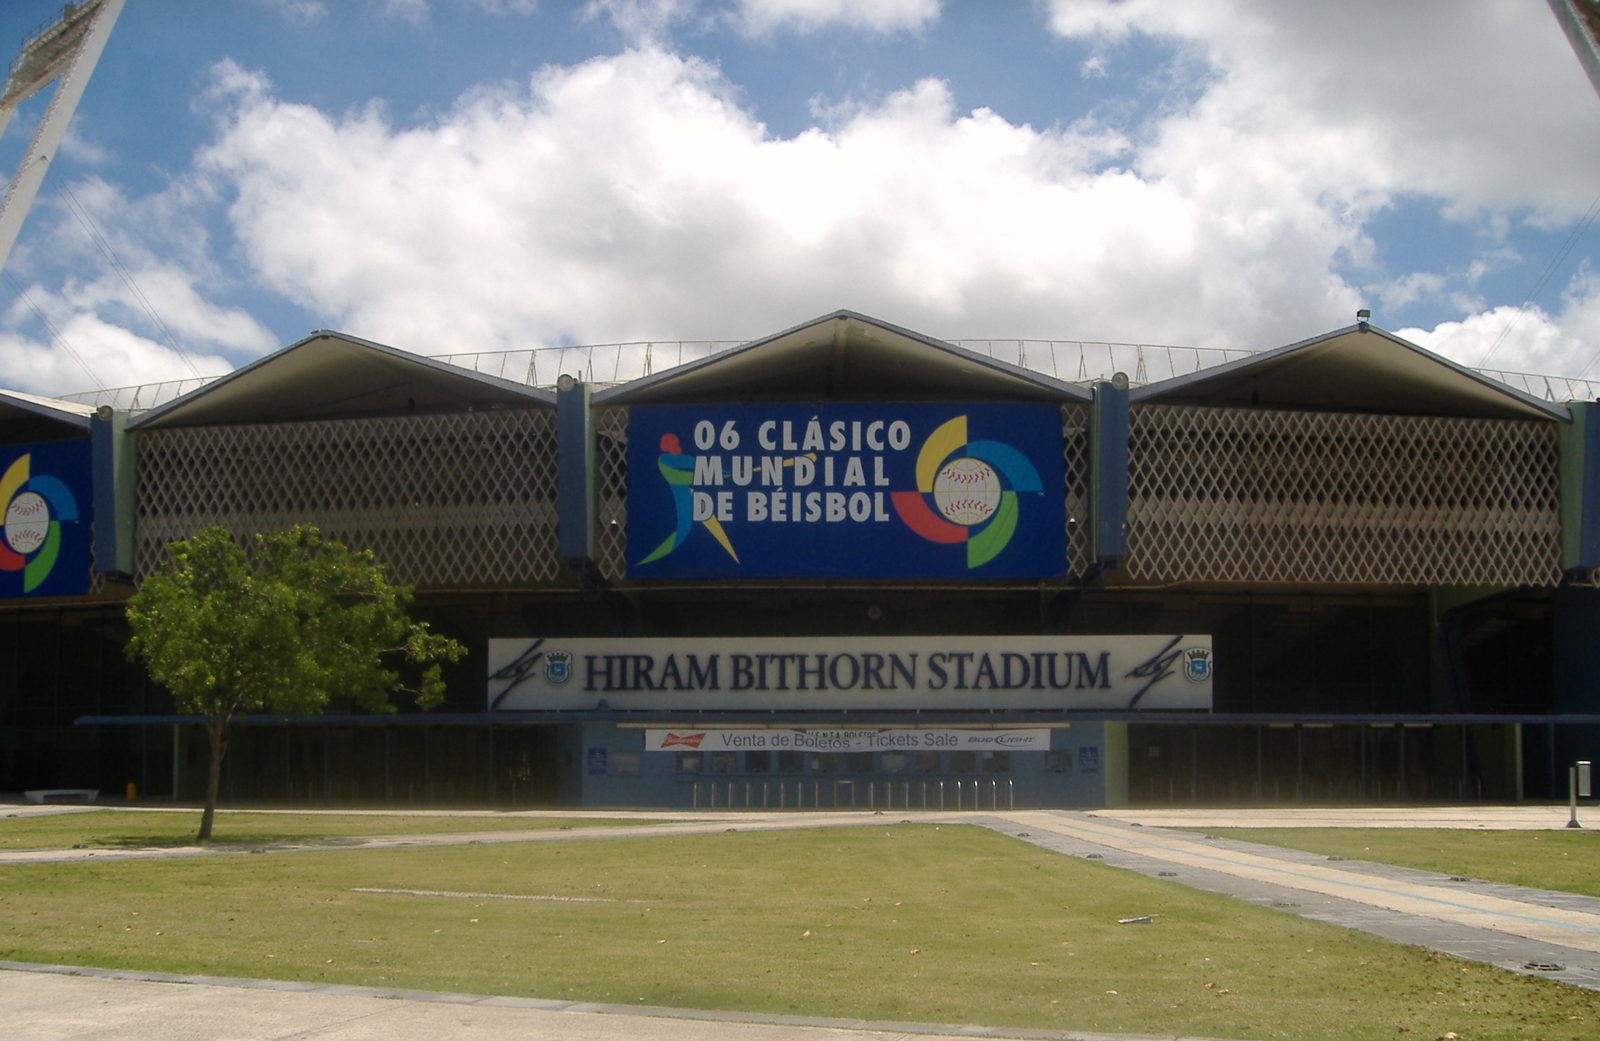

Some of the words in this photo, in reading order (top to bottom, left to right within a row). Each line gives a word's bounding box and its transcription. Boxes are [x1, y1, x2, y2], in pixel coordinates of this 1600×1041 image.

[693, 420, 741, 450] 06
[757, 415, 911, 451] CLÁSICO
[693, 455, 890, 487] MUNDIAL
[692, 491, 733, 522] DE
[747, 486, 890, 522] BÉISBOL
[583, 653, 721, 692] HIRAM
[729, 652, 919, 691] BITHORN
[927, 651, 1112, 690] STADIUM
[721, 733, 766, 747] Venta
[770, 732, 790, 747] de
[793, 733, 851, 749] Boletos
[868, 732, 919, 747] Tickets
[923, 732, 959, 747] Sale
